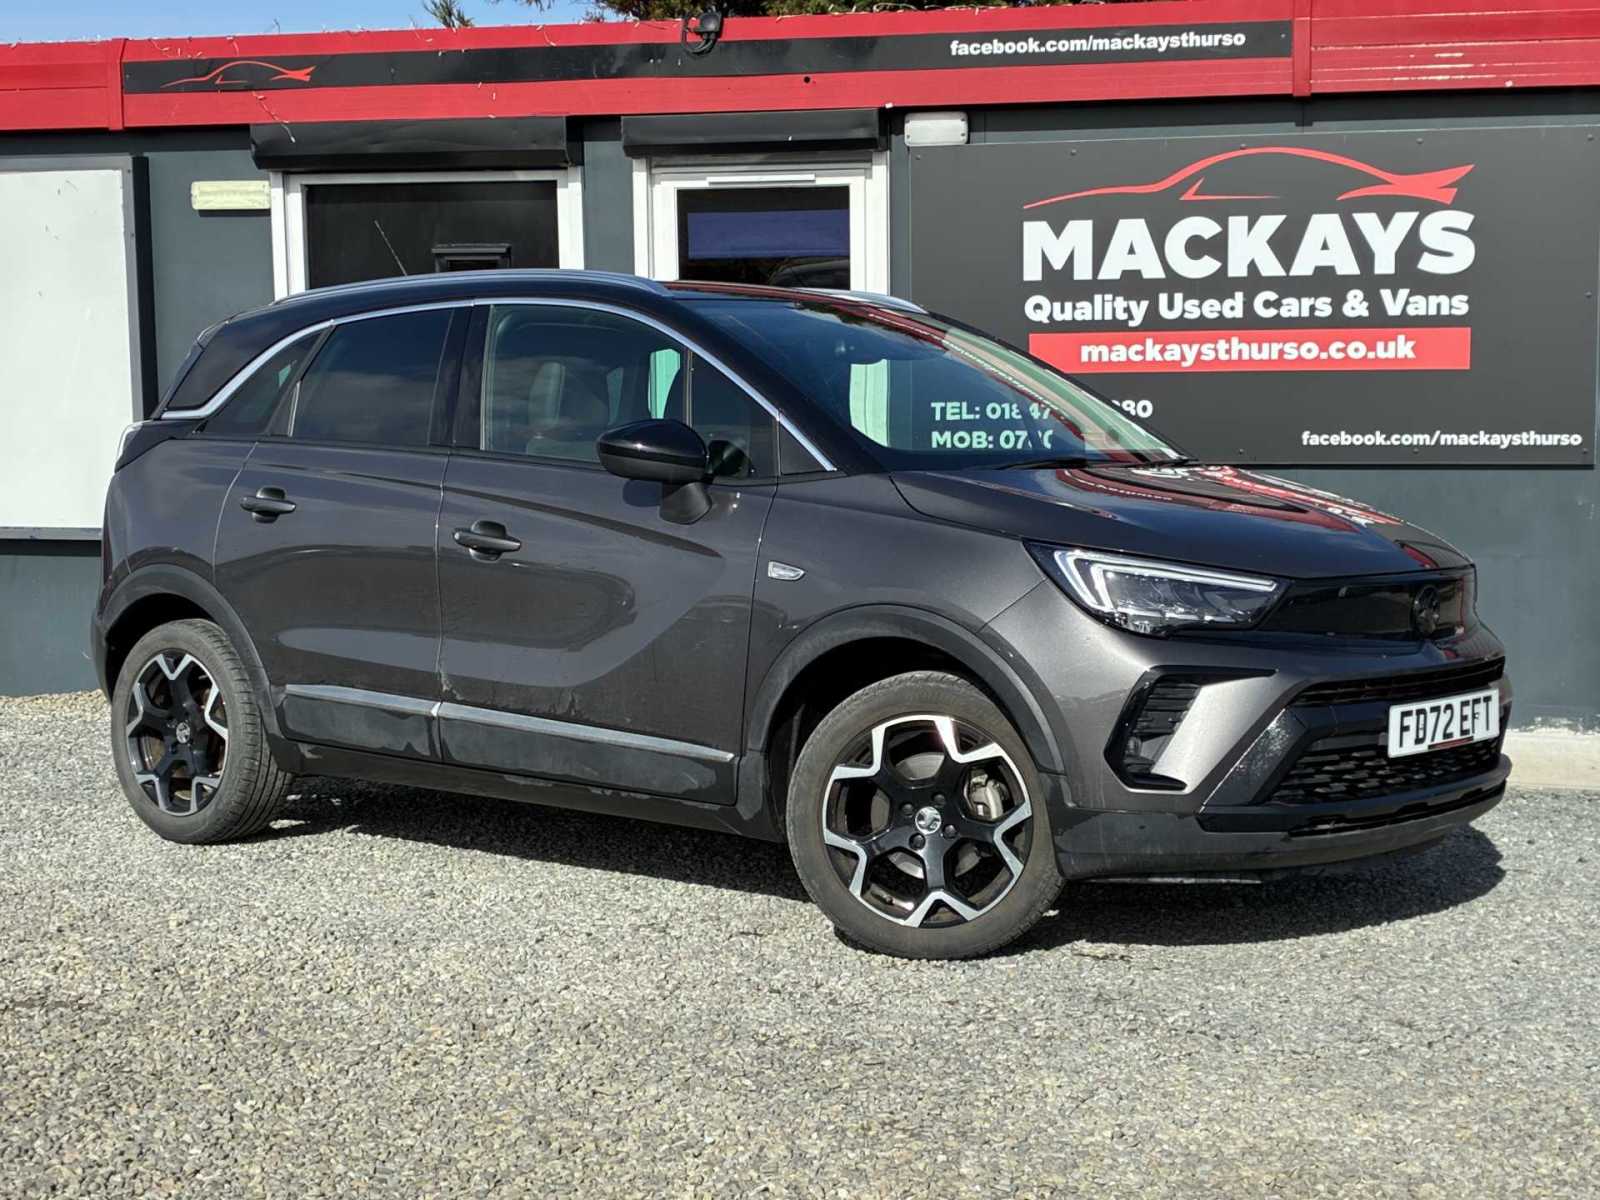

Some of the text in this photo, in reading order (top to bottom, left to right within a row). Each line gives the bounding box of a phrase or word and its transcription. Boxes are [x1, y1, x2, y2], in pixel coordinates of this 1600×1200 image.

[950, 31, 1246, 56] facebook.com/mackaysthurso
[1022, 210, 1476, 282] MACKAYS
[1024, 288, 1470, 328] Quality Used Cars & Vans
[1080, 335, 1416, 369] mackaysthurso.co.uk
[930, 401, 981, 421] TEL:
[931, 430, 994, 449] MOB:
[1301, 430, 1583, 450] facebook.com/mackaysthurso
[1399, 695, 1492, 748] FD72 EFT
